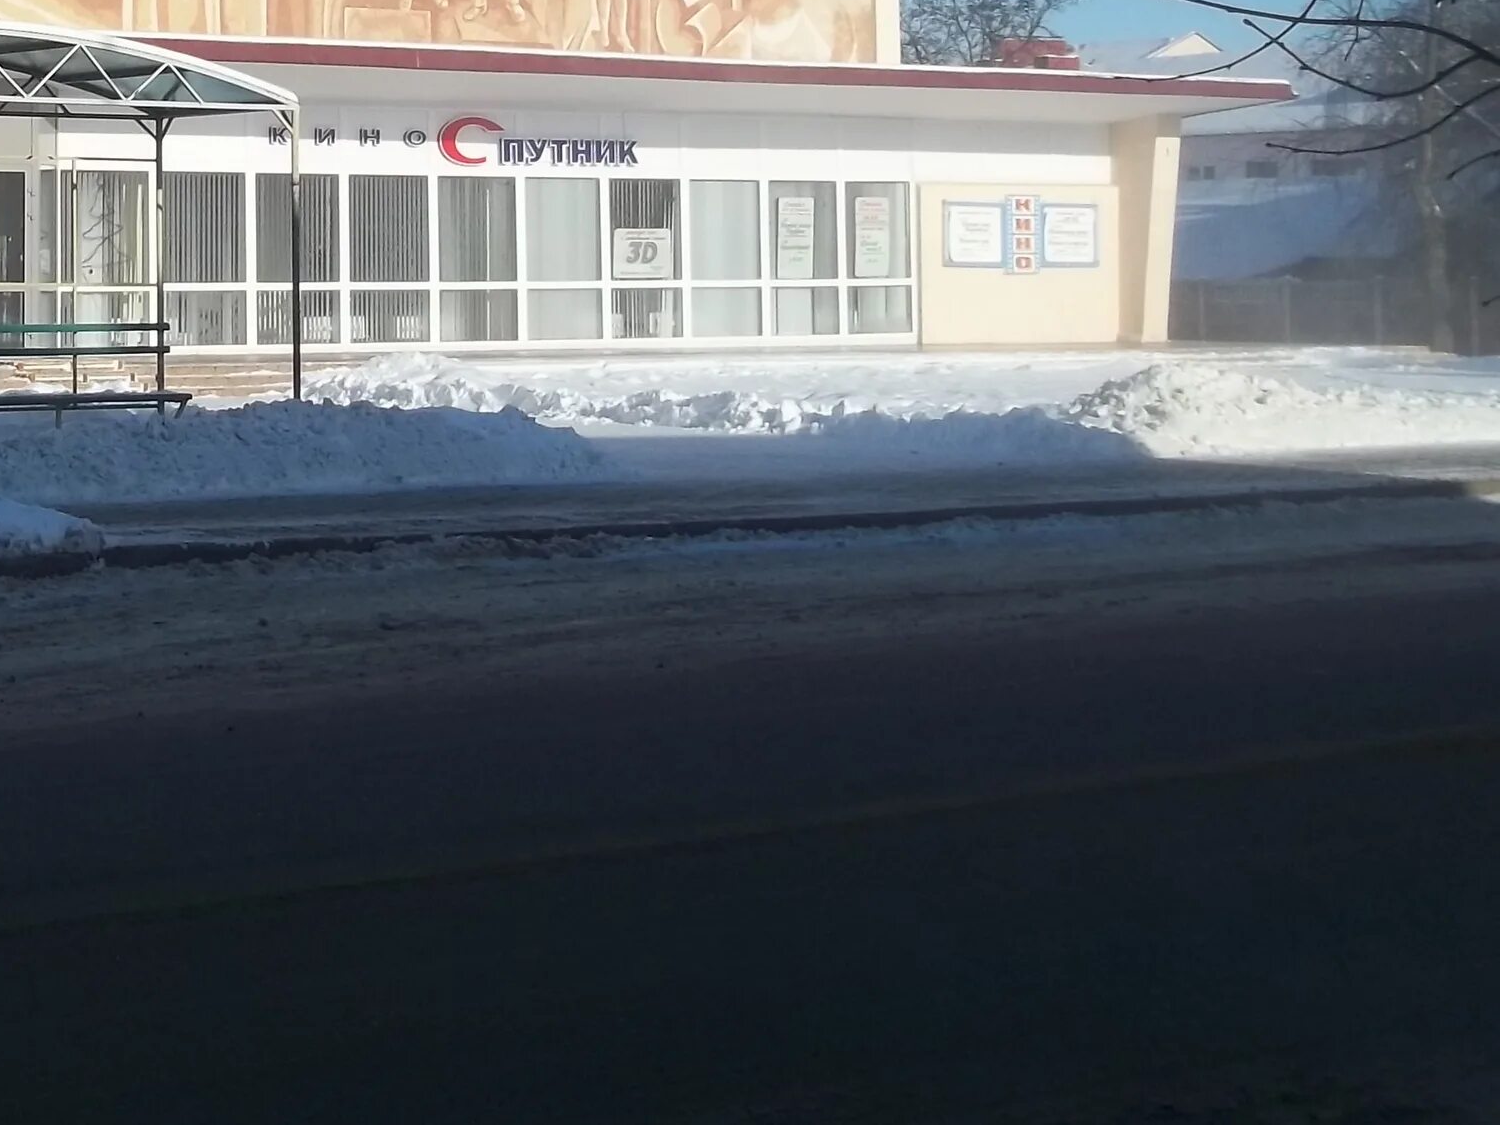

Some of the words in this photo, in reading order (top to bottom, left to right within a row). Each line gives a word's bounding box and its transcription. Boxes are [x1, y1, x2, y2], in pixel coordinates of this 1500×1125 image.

[269, 126, 427, 147] КИНО
[437, 116, 638, 166] СПУТНИК
[626, 241, 658, 264] 3D
[1014, 198, 1033, 269] КИНО
